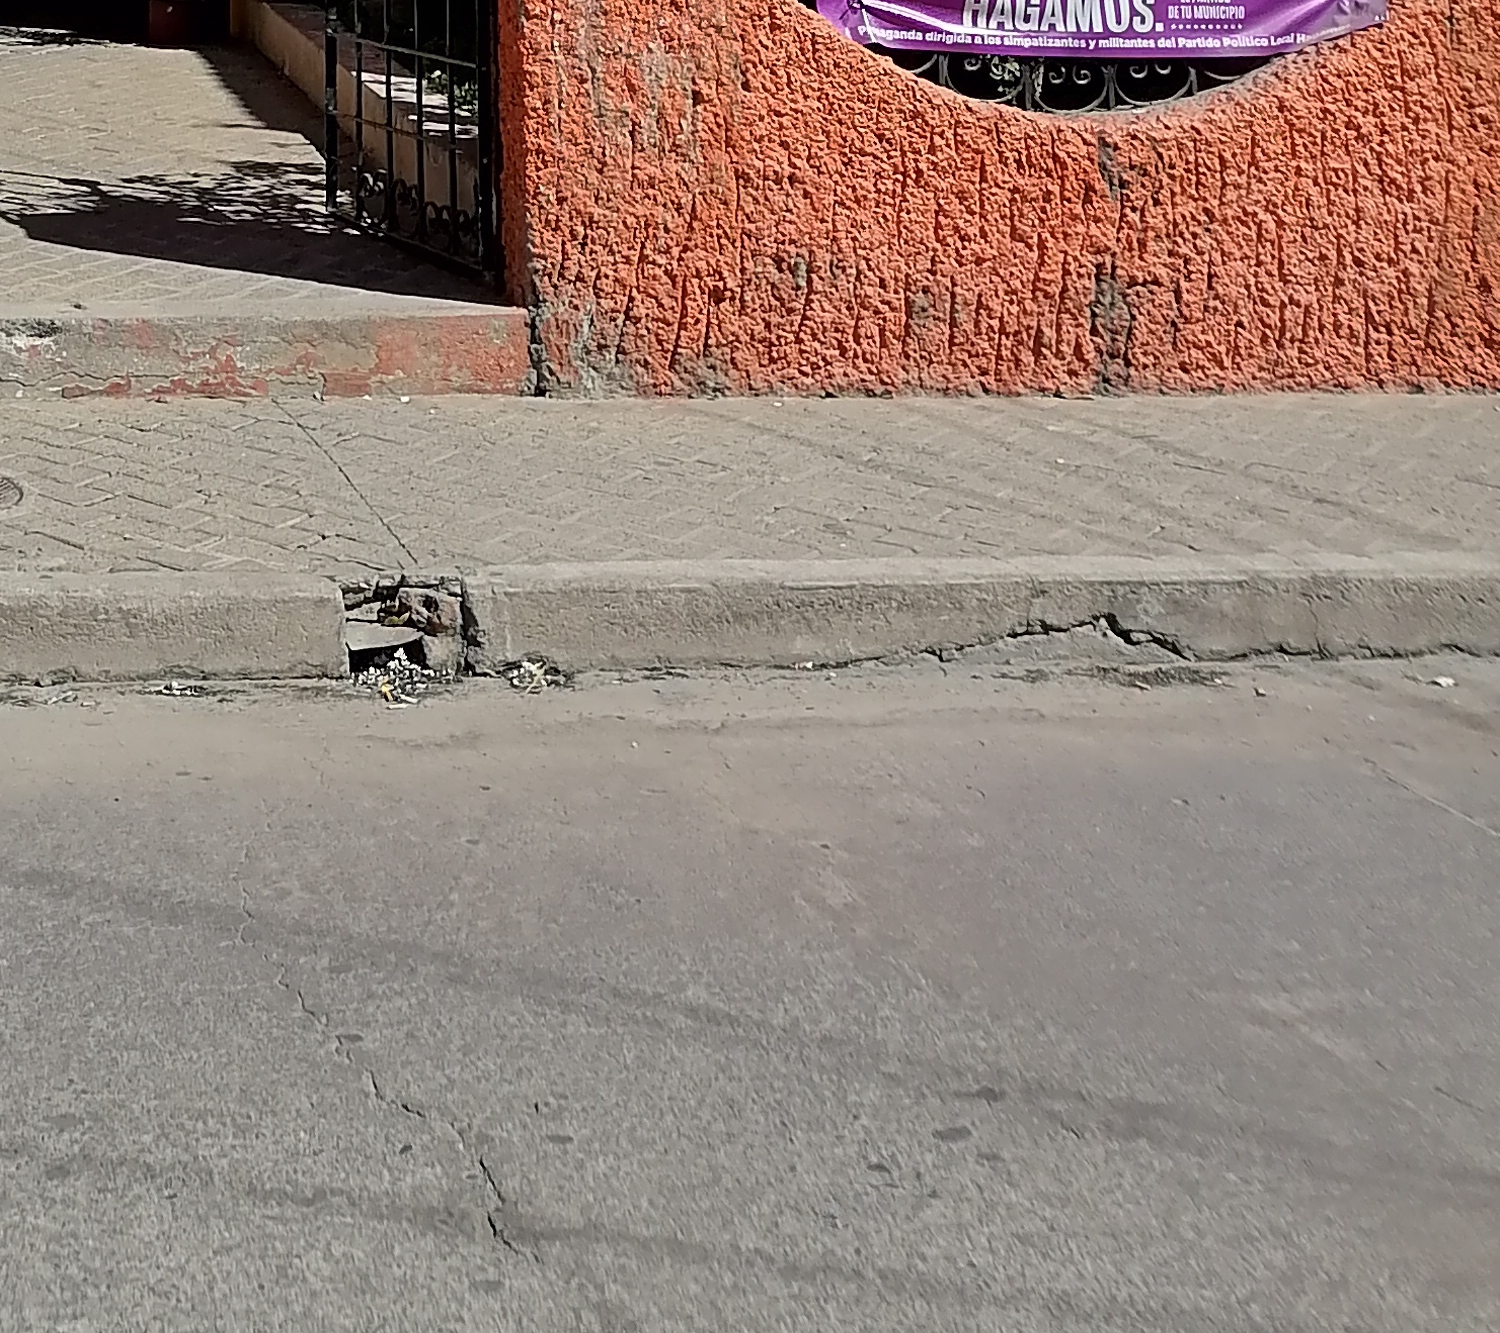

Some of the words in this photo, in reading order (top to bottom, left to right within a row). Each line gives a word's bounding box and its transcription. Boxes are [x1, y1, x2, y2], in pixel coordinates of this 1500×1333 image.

[1168, 5, 1179, 19] DE
[1180, 5, 1192, 19] TU
[1193, 5, 1245, 19] MUNICIPIO
[925, 32, 972, 44] dirigida
[974, 35, 983, 44] a
[983, 34, 1002, 45] los
[1003, 34, 1086, 49] simpatizantes
[1088, 39, 1096, 50] y
[1099, 37, 1155, 49] militantes
[1157, 37, 1176, 48] del
[1178, 37, 1221, 49] Partido
